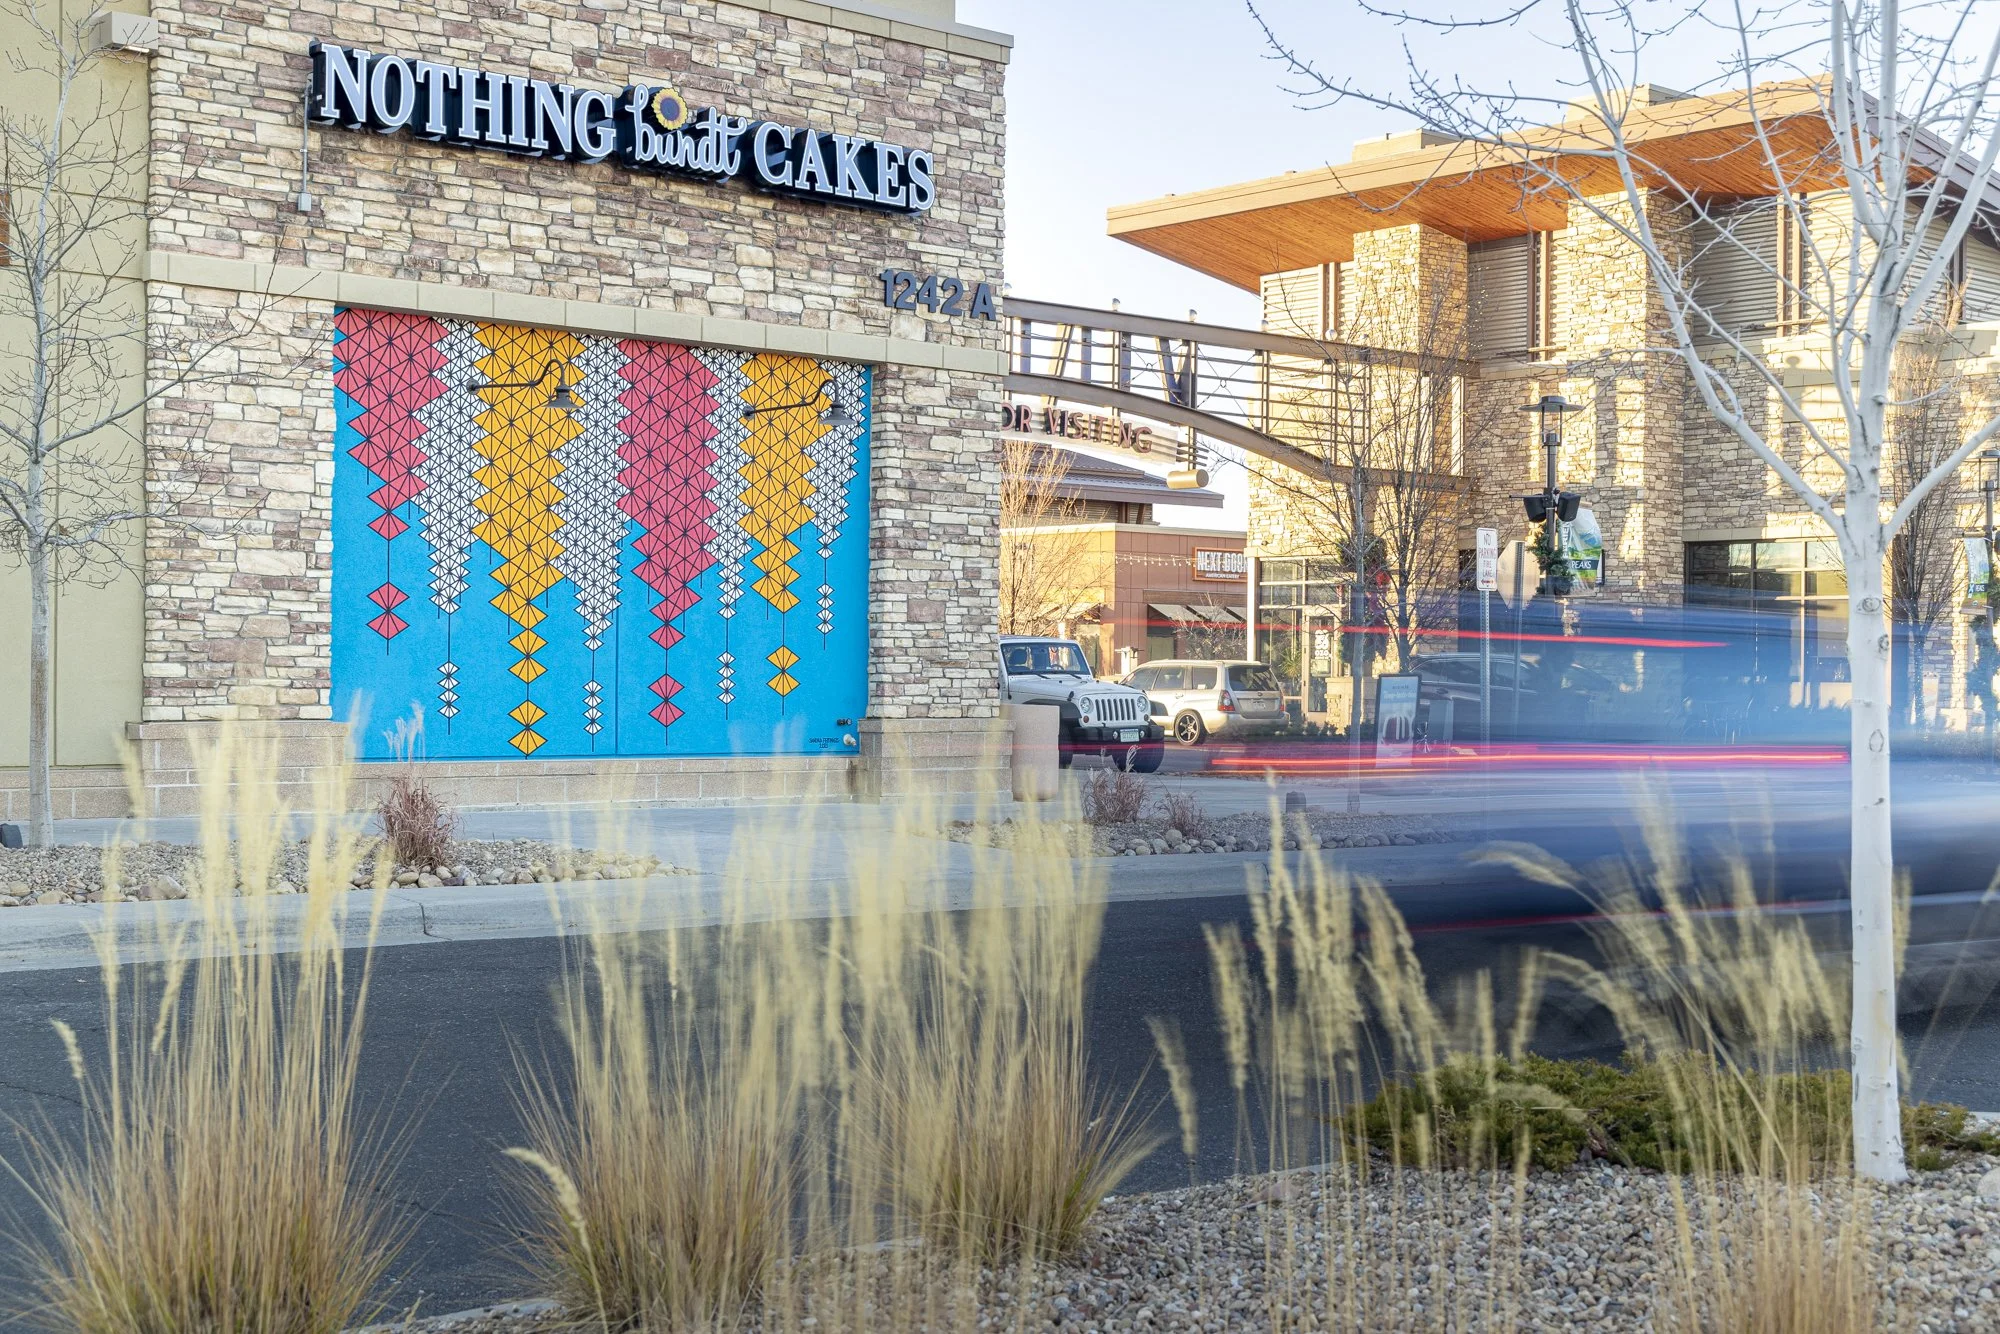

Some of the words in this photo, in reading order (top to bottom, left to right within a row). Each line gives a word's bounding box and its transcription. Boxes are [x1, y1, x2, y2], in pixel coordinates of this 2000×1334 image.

[320, 43, 617, 158] NOTHING
[625, 83, 747, 177] bundt
[754, 120, 936, 211] CAKES
[880, 268, 964, 316] 1242
[970, 282, 997, 321] A
[1044, 406, 1153, 454] VISITING
[1483, 534, 1492, 546] NO
[1197, 551, 1222, 571] NEXT
[1479, 547, 1497, 559] PARKING
[1571, 560, 1592, 569] PEAKS
[1482, 569, 1493, 578] LANE
